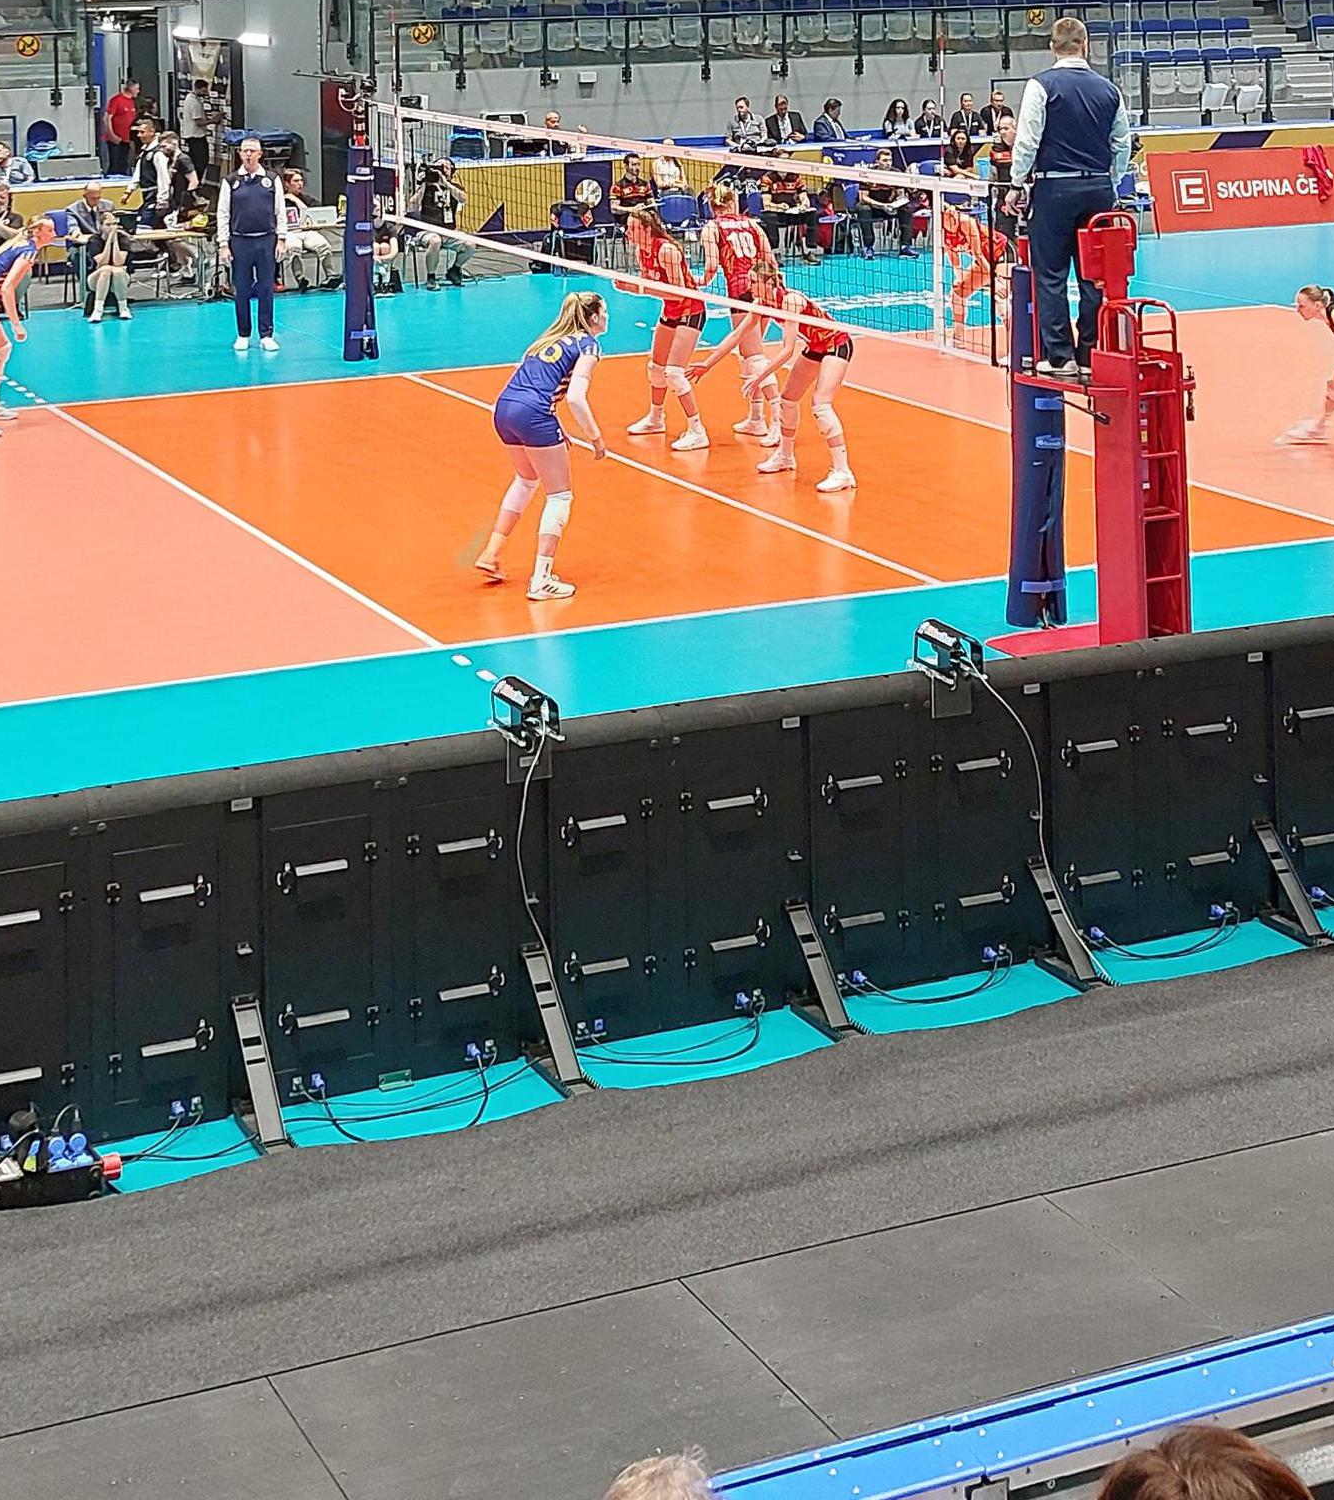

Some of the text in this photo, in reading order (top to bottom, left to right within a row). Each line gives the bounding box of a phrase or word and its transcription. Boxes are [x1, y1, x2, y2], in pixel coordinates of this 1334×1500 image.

[1217, 178, 1291, 199] SKUPINA
[1295, 173, 1319, 196] ČE
[727, 231, 757, 259] 10
